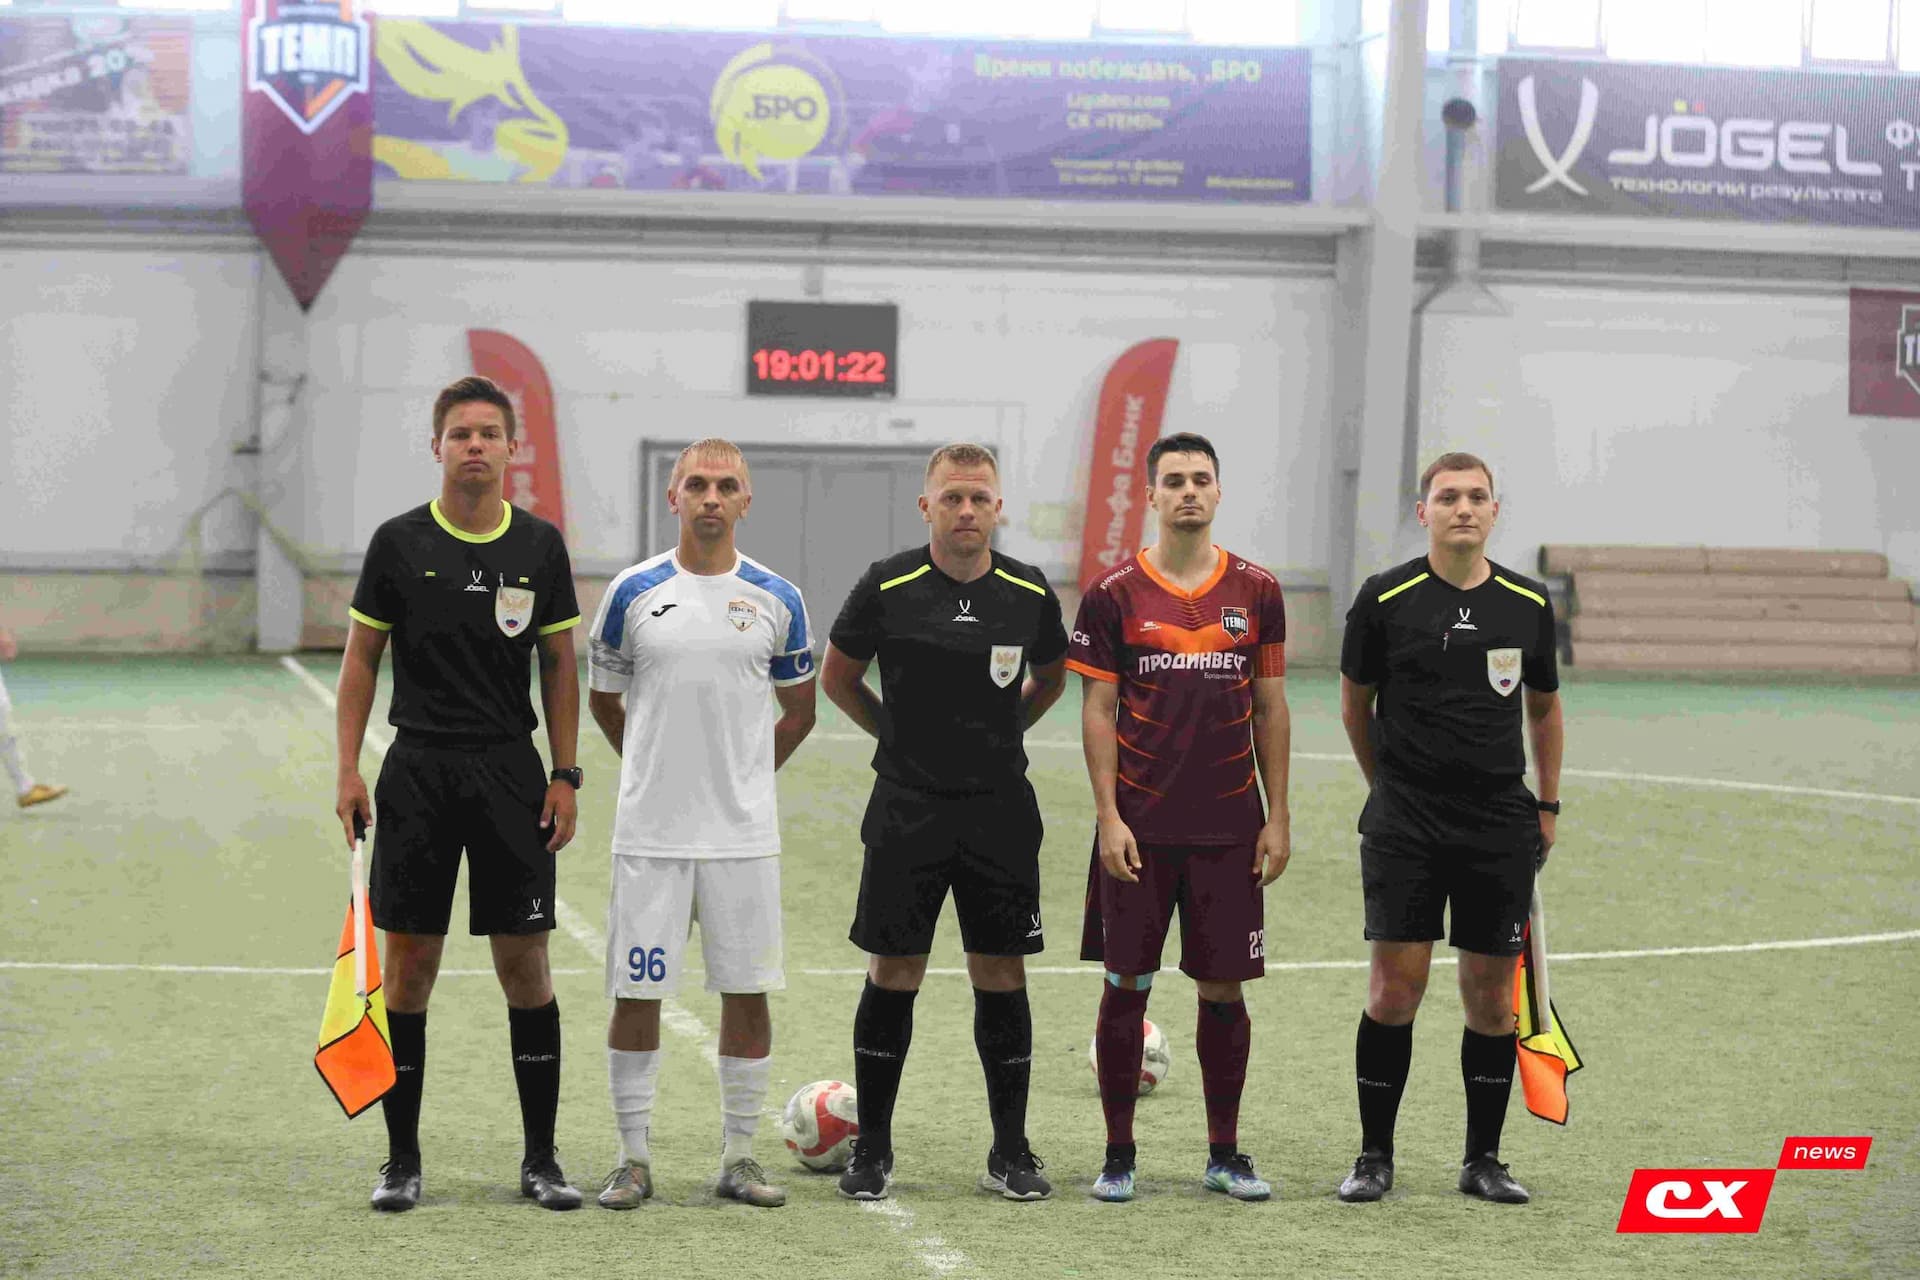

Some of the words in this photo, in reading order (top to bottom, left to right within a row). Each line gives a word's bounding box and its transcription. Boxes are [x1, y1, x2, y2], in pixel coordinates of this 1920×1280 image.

[259, 21, 358, 76] ТЕМП
[753, 349, 886, 383] 19:01:22
[1112, 394, 1145, 469] Банк
[628, 946, 666, 982] 96
